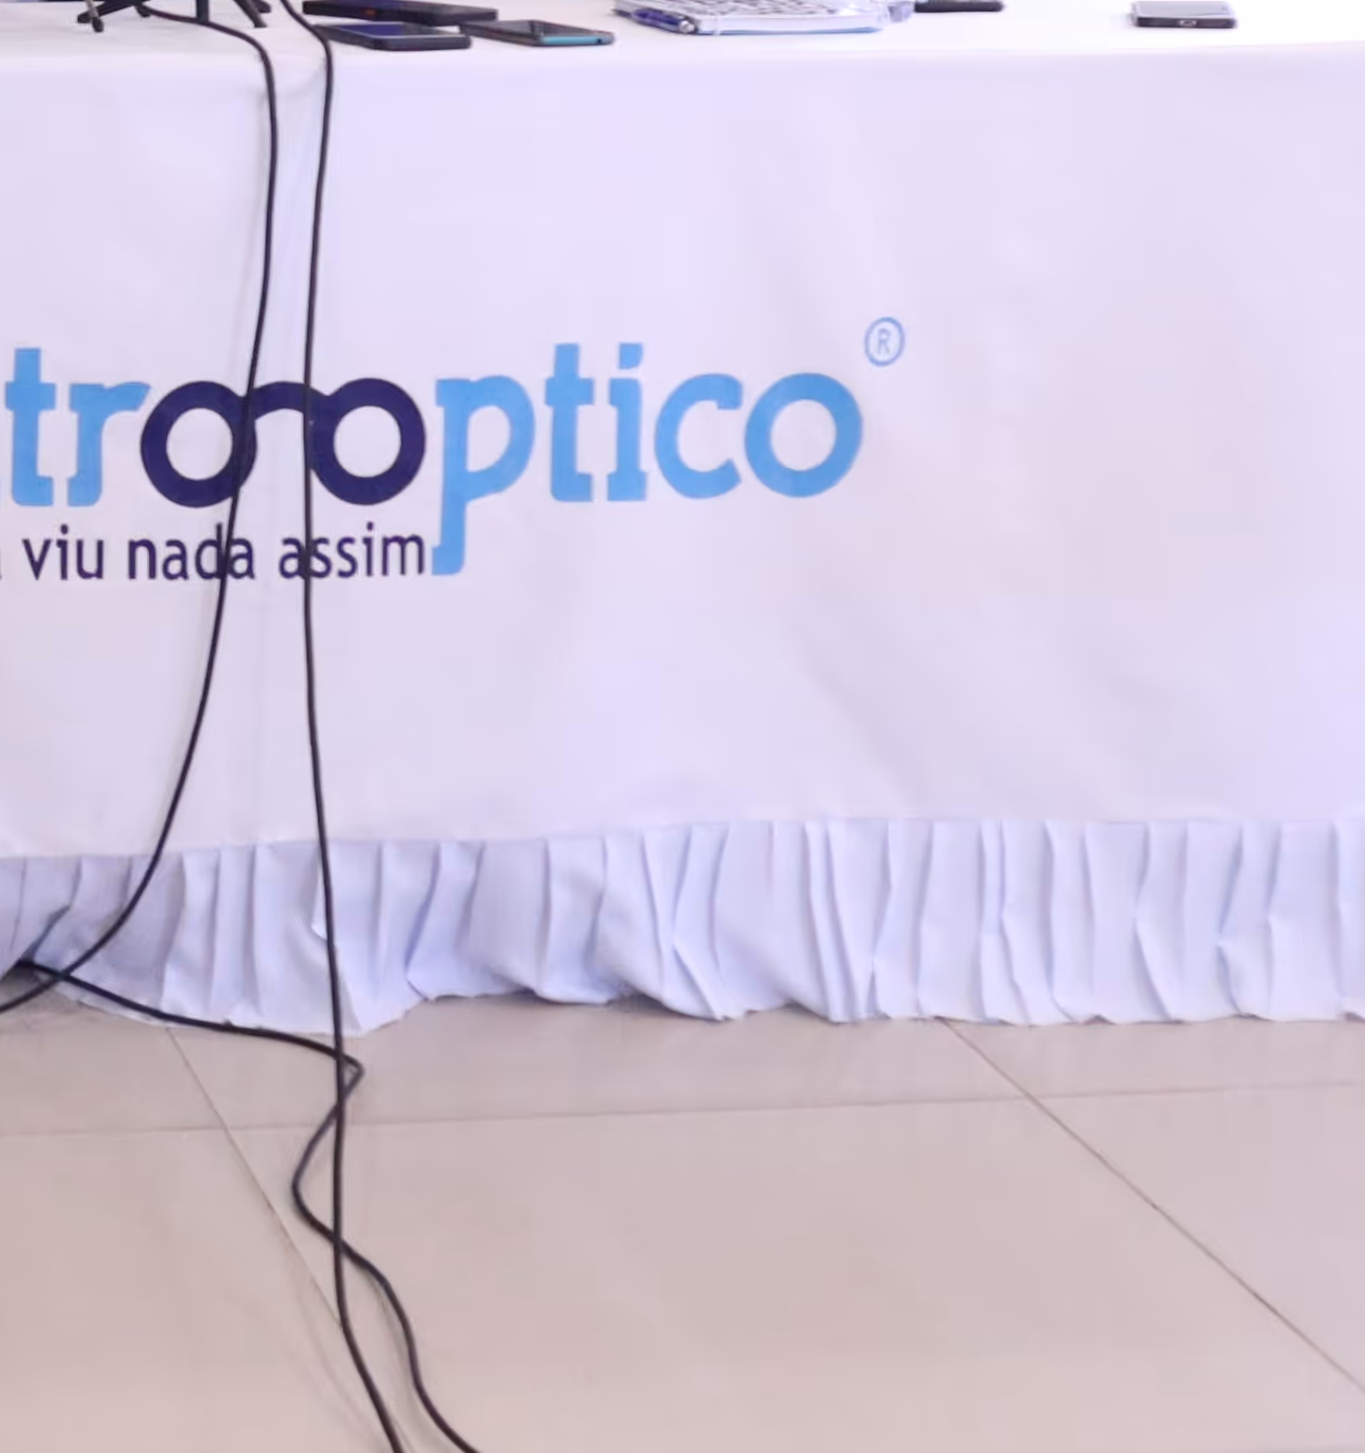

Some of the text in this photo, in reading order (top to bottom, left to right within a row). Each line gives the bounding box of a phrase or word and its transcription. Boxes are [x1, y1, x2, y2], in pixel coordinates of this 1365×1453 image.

[22, 523, 105, 581] viu
[128, 522, 256, 581] nada
[279, 522, 426, 579] assim
